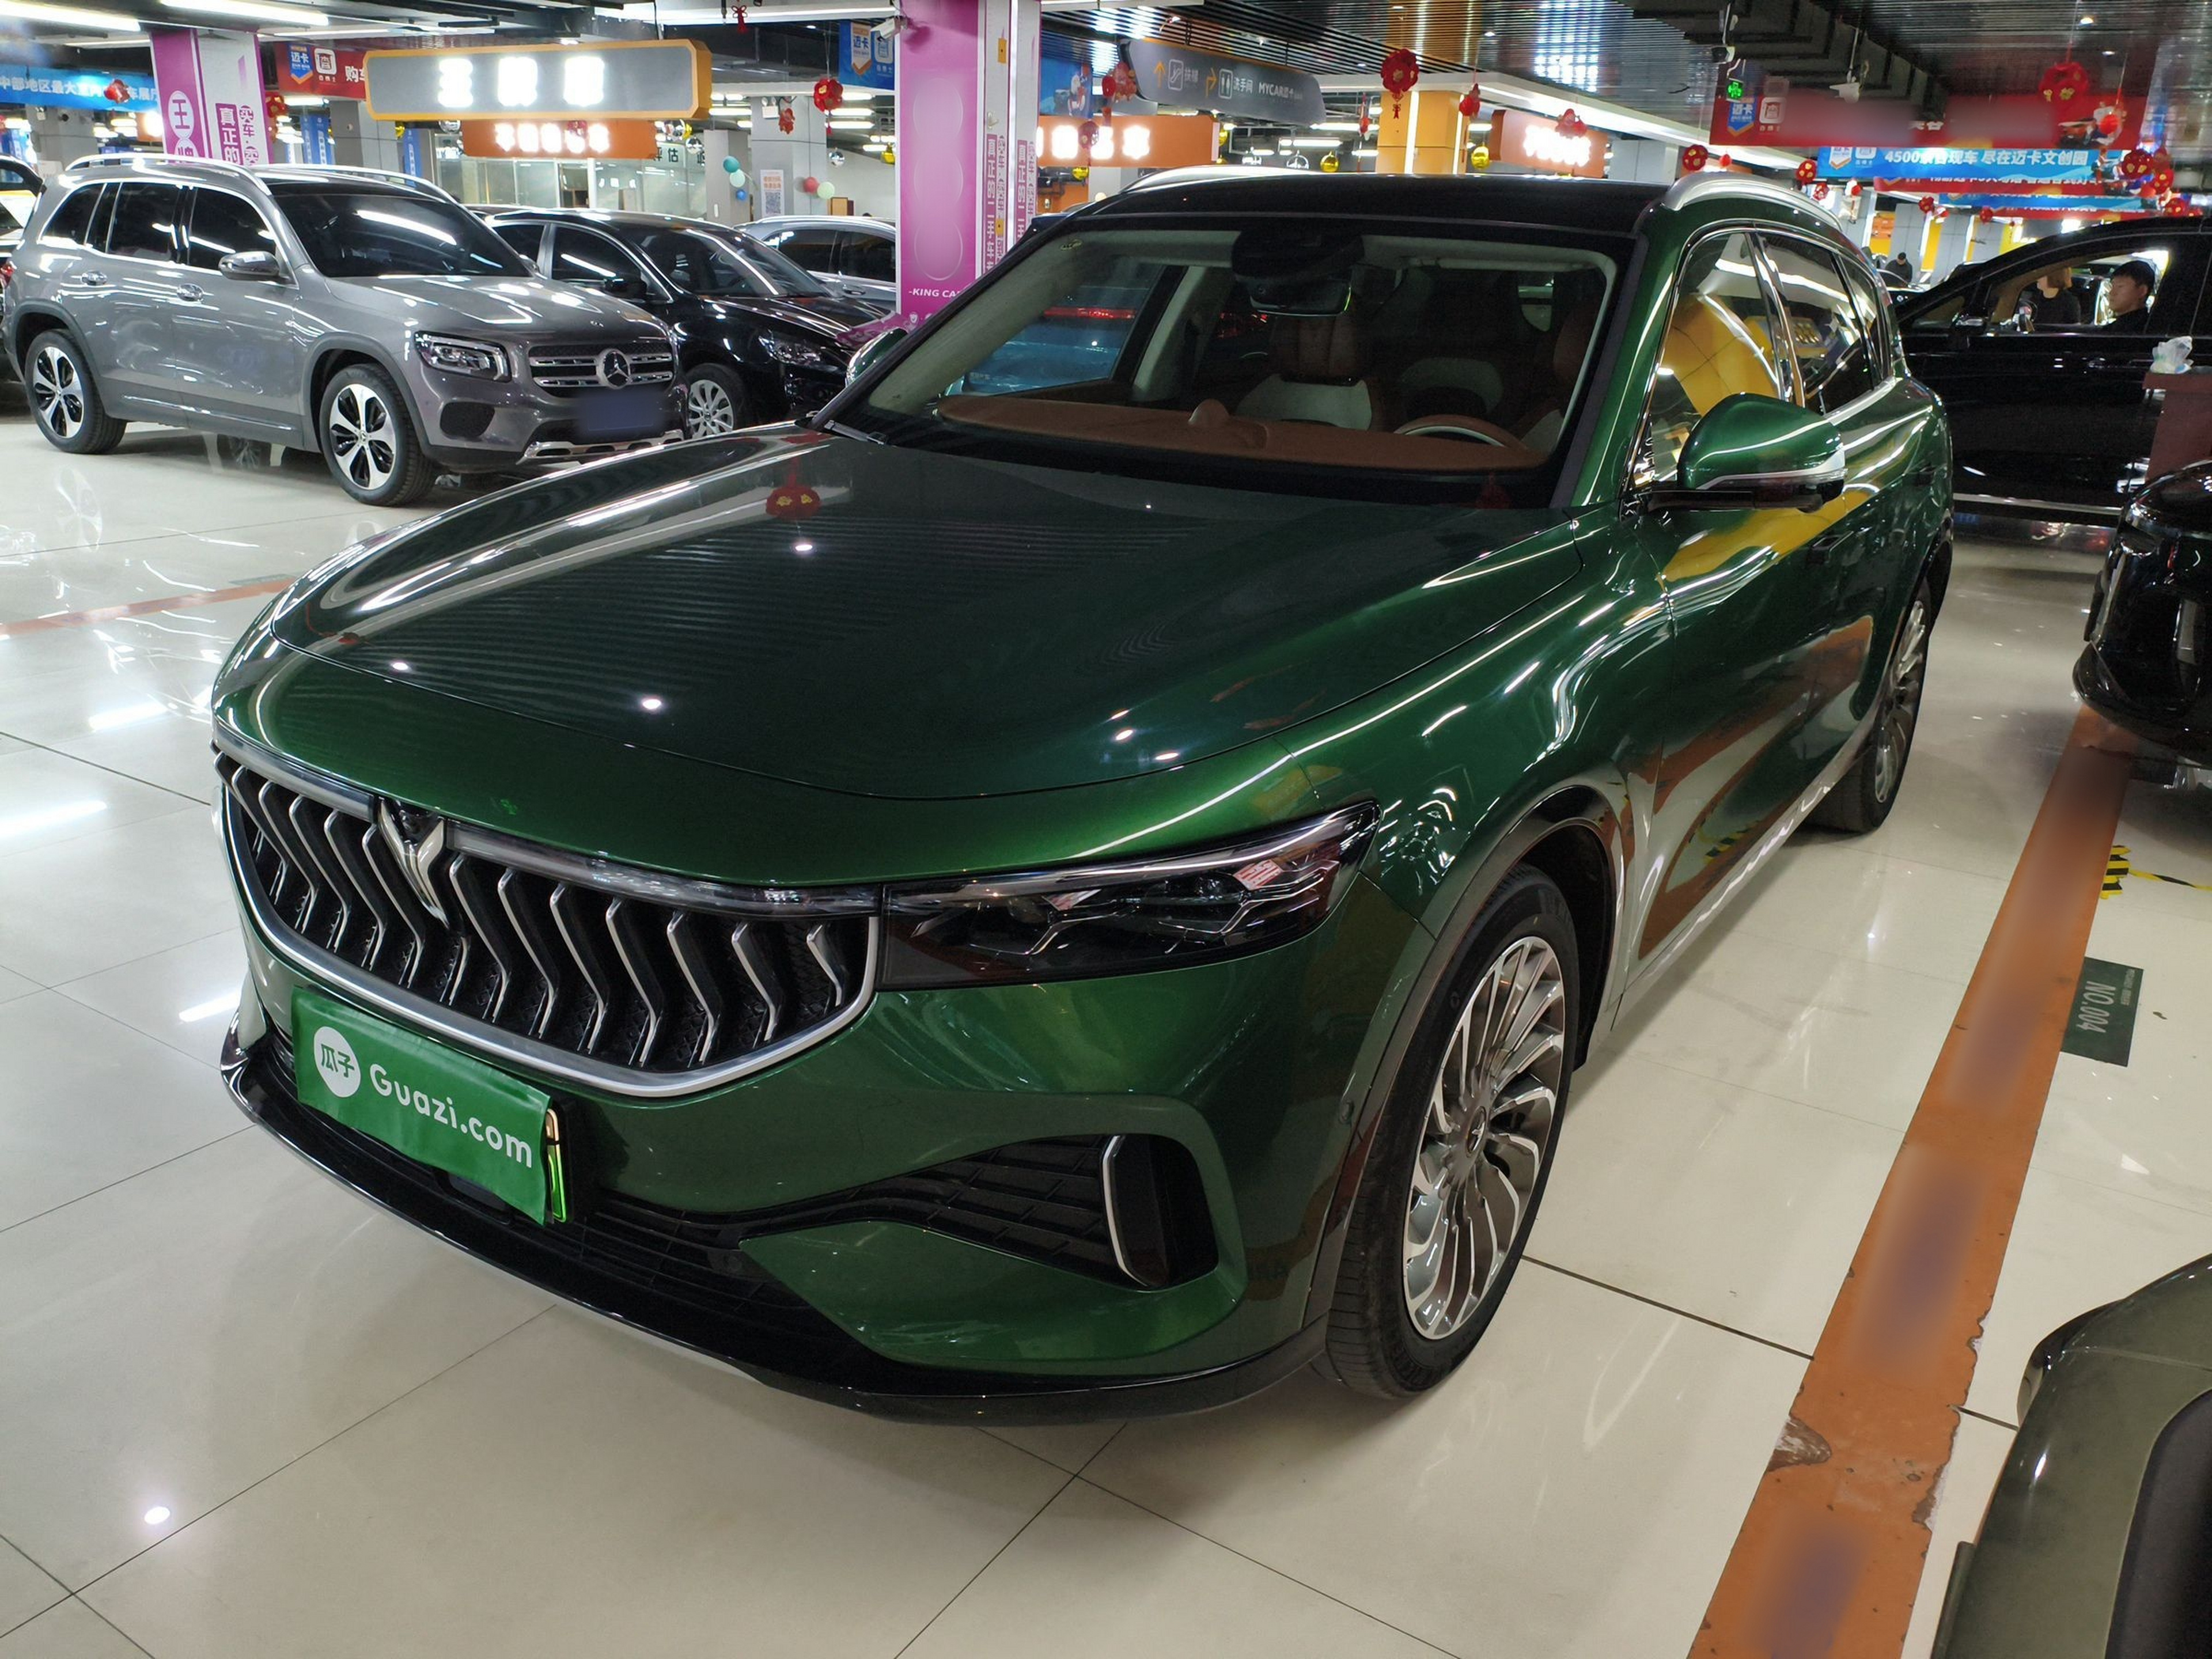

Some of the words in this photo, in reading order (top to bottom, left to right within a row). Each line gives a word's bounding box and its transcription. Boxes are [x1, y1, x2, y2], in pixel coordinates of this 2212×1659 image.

[1981, 150, 2089, 165] 尽在迈卡文创园
[2075, 980, 2116, 1033] NO.004
[321, 1044, 355, 1078] 瓜子
[369, 1063, 532, 1168] Guazi.com
